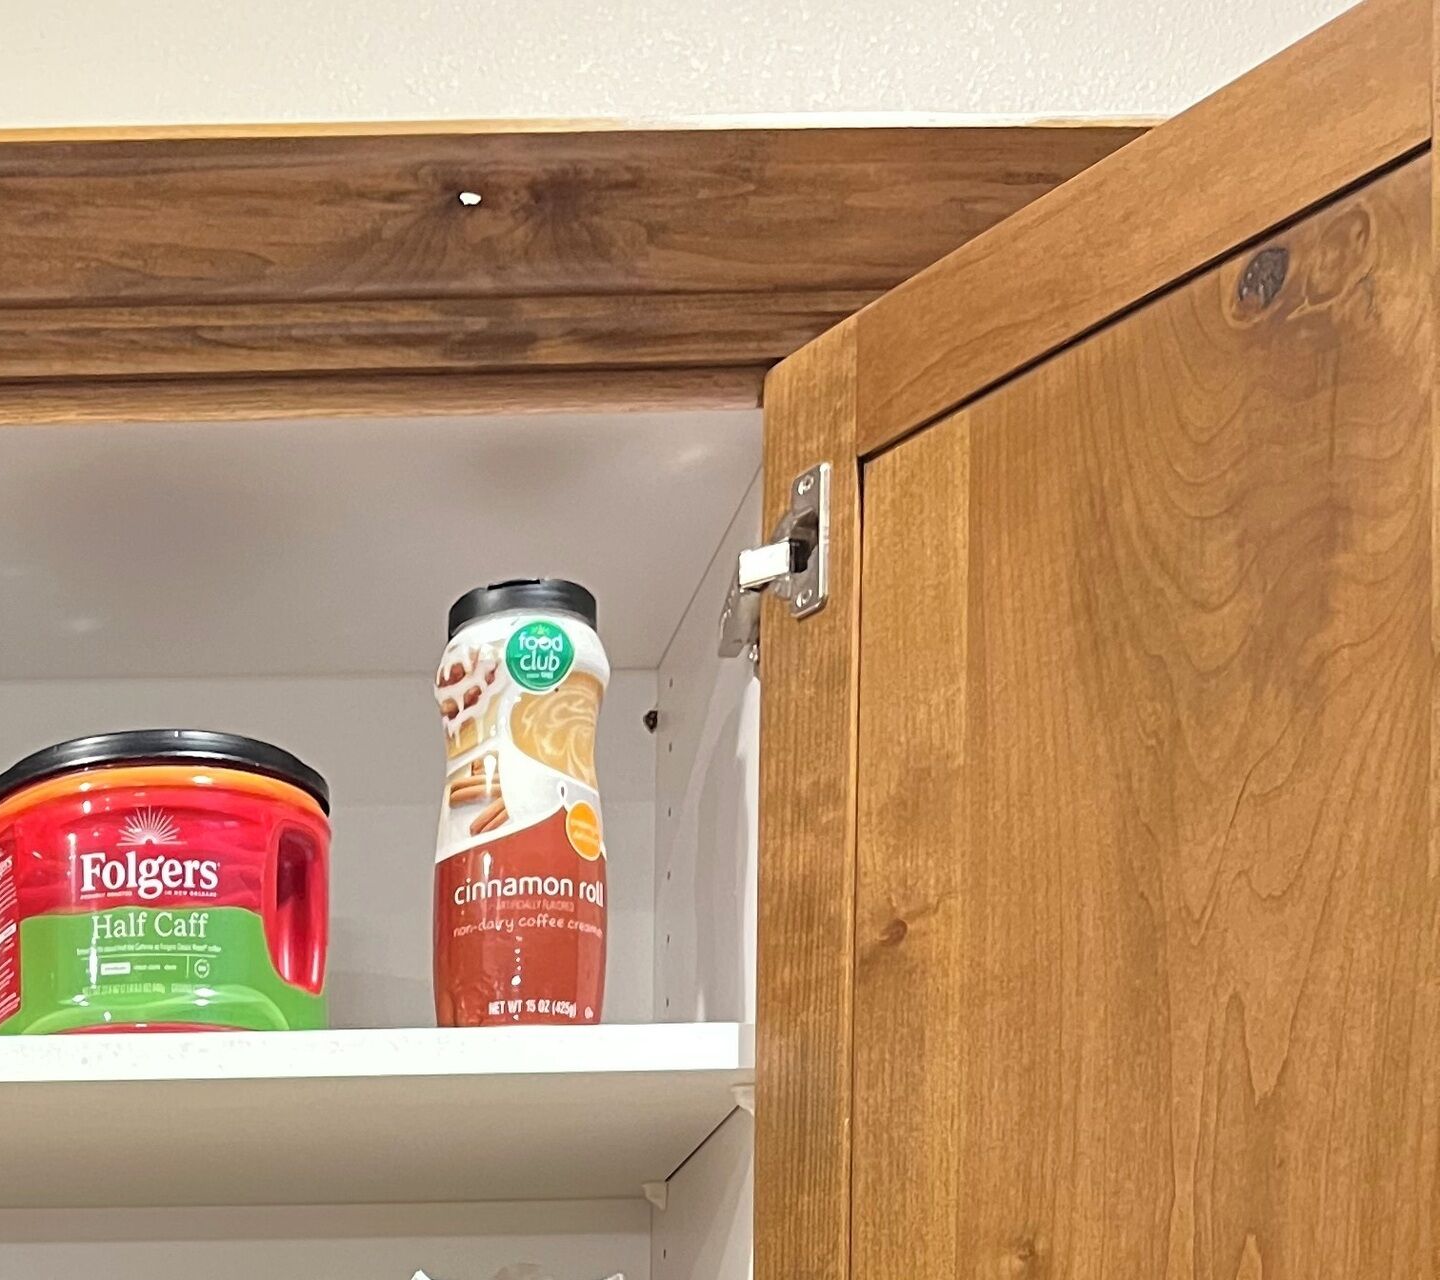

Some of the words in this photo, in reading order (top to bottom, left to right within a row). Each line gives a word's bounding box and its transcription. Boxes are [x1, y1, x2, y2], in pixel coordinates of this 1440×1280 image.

[519, 631, 563, 652] food
[520, 650, 560, 671] club
[80, 851, 219, 899] Folgers
[455, 876, 573, 905] cinnamon
[579, 880, 604, 908] roll
[91, 912, 148, 939] Half
[154, 912, 209, 938] Caff
[518, 913, 564, 928] coffee
[489, 1001, 505, 1015] NET
[507, 1000, 523, 1013] WT
[526, 1000, 536, 1012] 15
[538, 1000, 550, 1013] OZ
